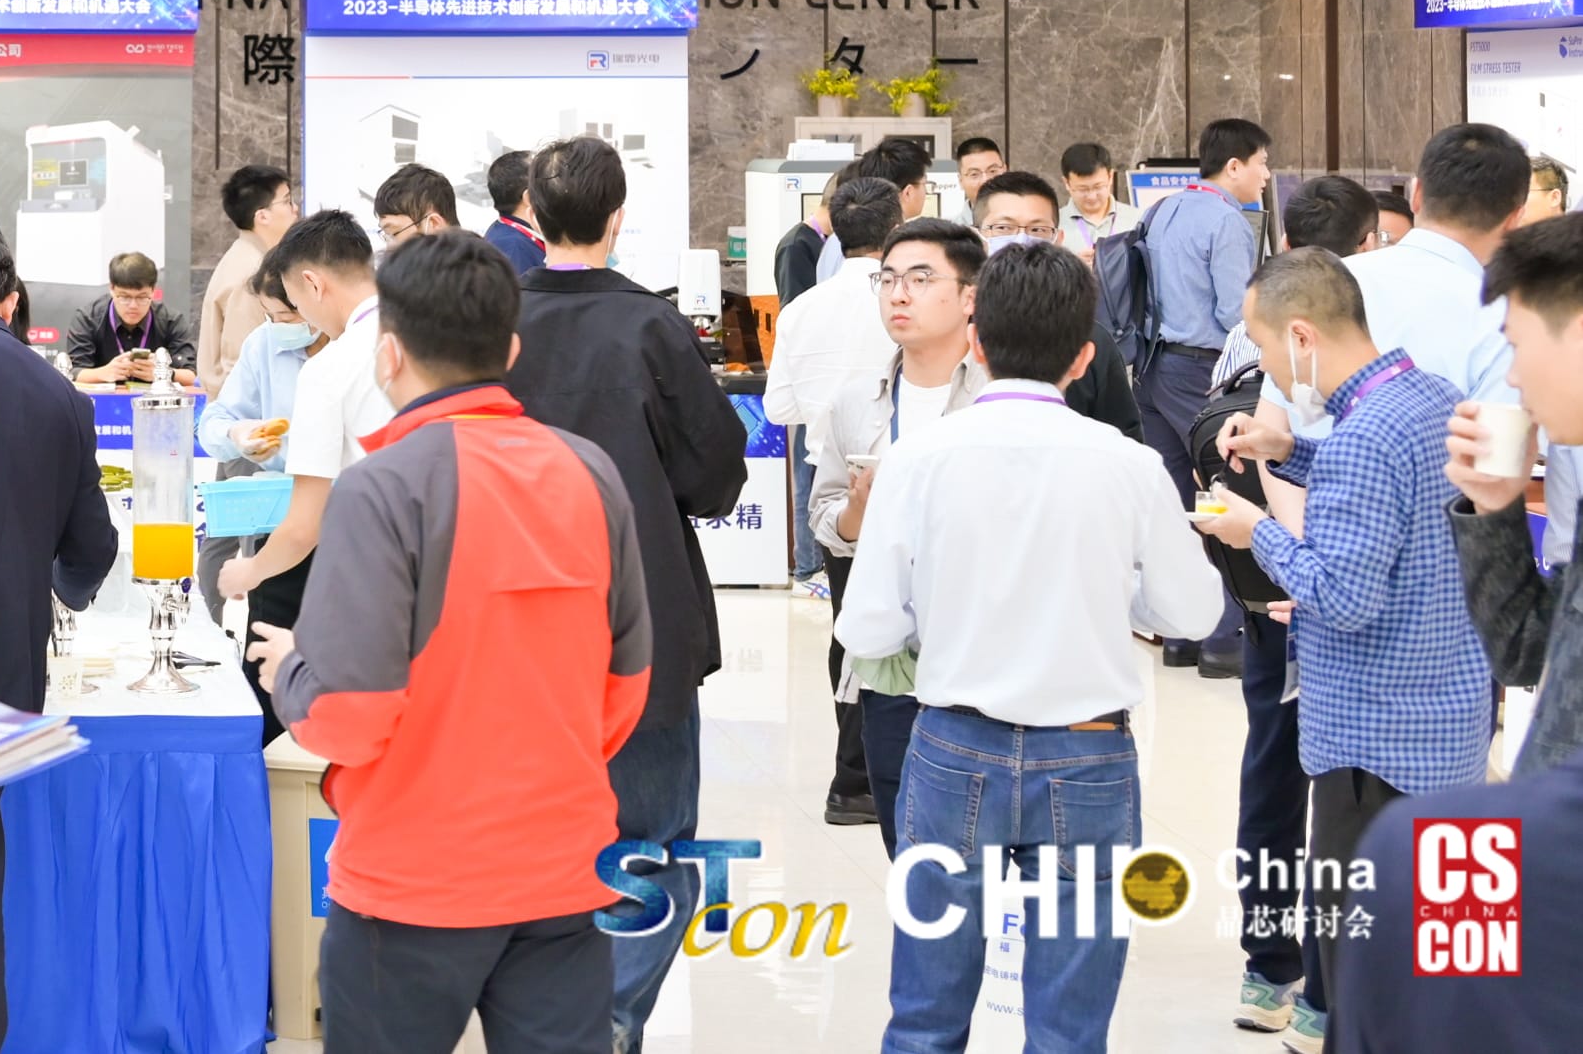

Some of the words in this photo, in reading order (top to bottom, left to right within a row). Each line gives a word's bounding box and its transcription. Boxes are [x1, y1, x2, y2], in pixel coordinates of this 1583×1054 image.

[244, 34, 296, 85] 際
[1470, 63, 1483, 74] FILM
[1483, 62, 1501, 74] STRESS
[1502, 62, 1521, 73] TESTER
